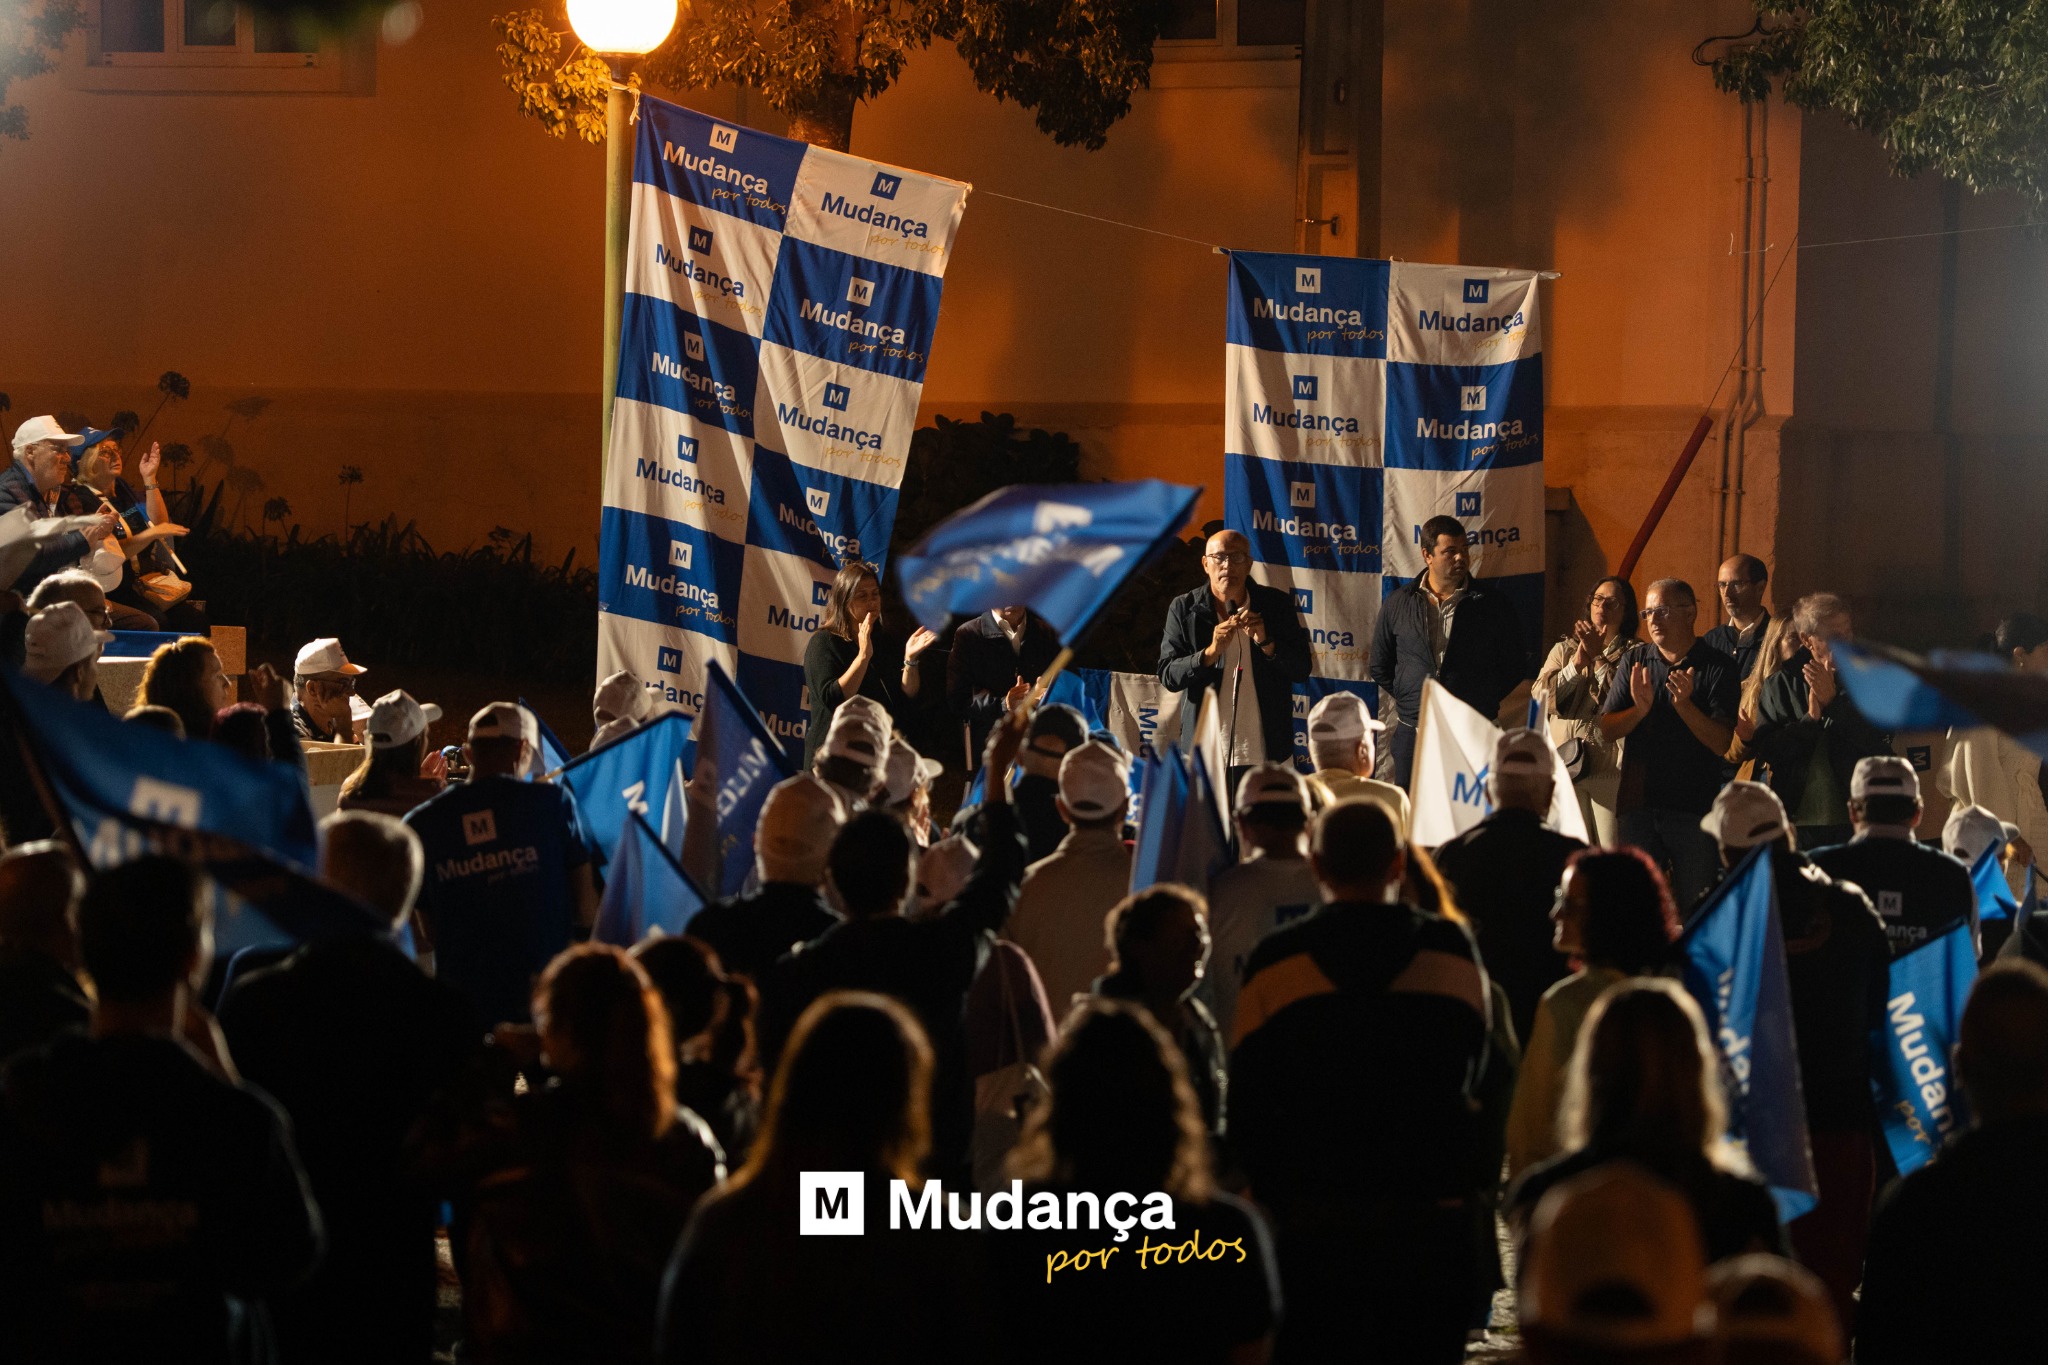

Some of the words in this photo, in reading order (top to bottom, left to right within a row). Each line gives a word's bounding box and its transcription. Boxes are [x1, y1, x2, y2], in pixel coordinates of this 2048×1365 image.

[716, 130, 731, 145] M
[663, 141, 768, 195] Mudança
[877, 179, 893, 193] M
[712, 187, 741, 201] por
[746, 193, 786, 214] todos
[821, 192, 928, 239] Mudança
[693, 232, 707, 249] M
[869, 234, 898, 249] por
[905, 236, 945, 257] todos
[656, 243, 744, 298] Mudança
[1302, 274, 1316, 287] M
[853, 284, 868, 299] M
[1469, 285, 1483, 298] M
[800, 299, 905, 344] Mudança
[1254, 298, 1362, 330] Mudança
[1419, 310, 1524, 335] Mudança
[1307, 328, 1336, 344] por
[1341, 327, 1384, 342] todos
[688, 339, 700, 354] M
[848, 340, 877, 354] por
[882, 342, 924, 363] todos
[829, 388, 844, 405] M
[1299, 381, 1313, 395] M
[1467, 392, 1480, 405] M
[778, 402, 883, 450] Mudança
[1253, 402, 1359, 436] Mudança
[1417, 417, 1523, 441] Mudança
[682, 441, 694, 457] M
[825, 445, 854, 460] por
[859, 446, 901, 468] todos
[636, 457, 725, 505] Mudança
[810, 494, 823, 509] M
[1297, 488, 1310, 502] M
[1461, 498, 1476, 511] M
[1253, 510, 1357, 543] Mudança
[675, 548, 687, 561] M
[1304, 543, 1330, 558] por
[1337, 541, 1379, 555] todos
[625, 564, 719, 609] Mudança
[1295, 593, 1308, 608] M
[676, 604, 700, 617] por
[705, 608, 735, 628] todos
[663, 652, 677, 668] M
[471, 818, 488, 835] M
[435, 846, 539, 882] Mudança
